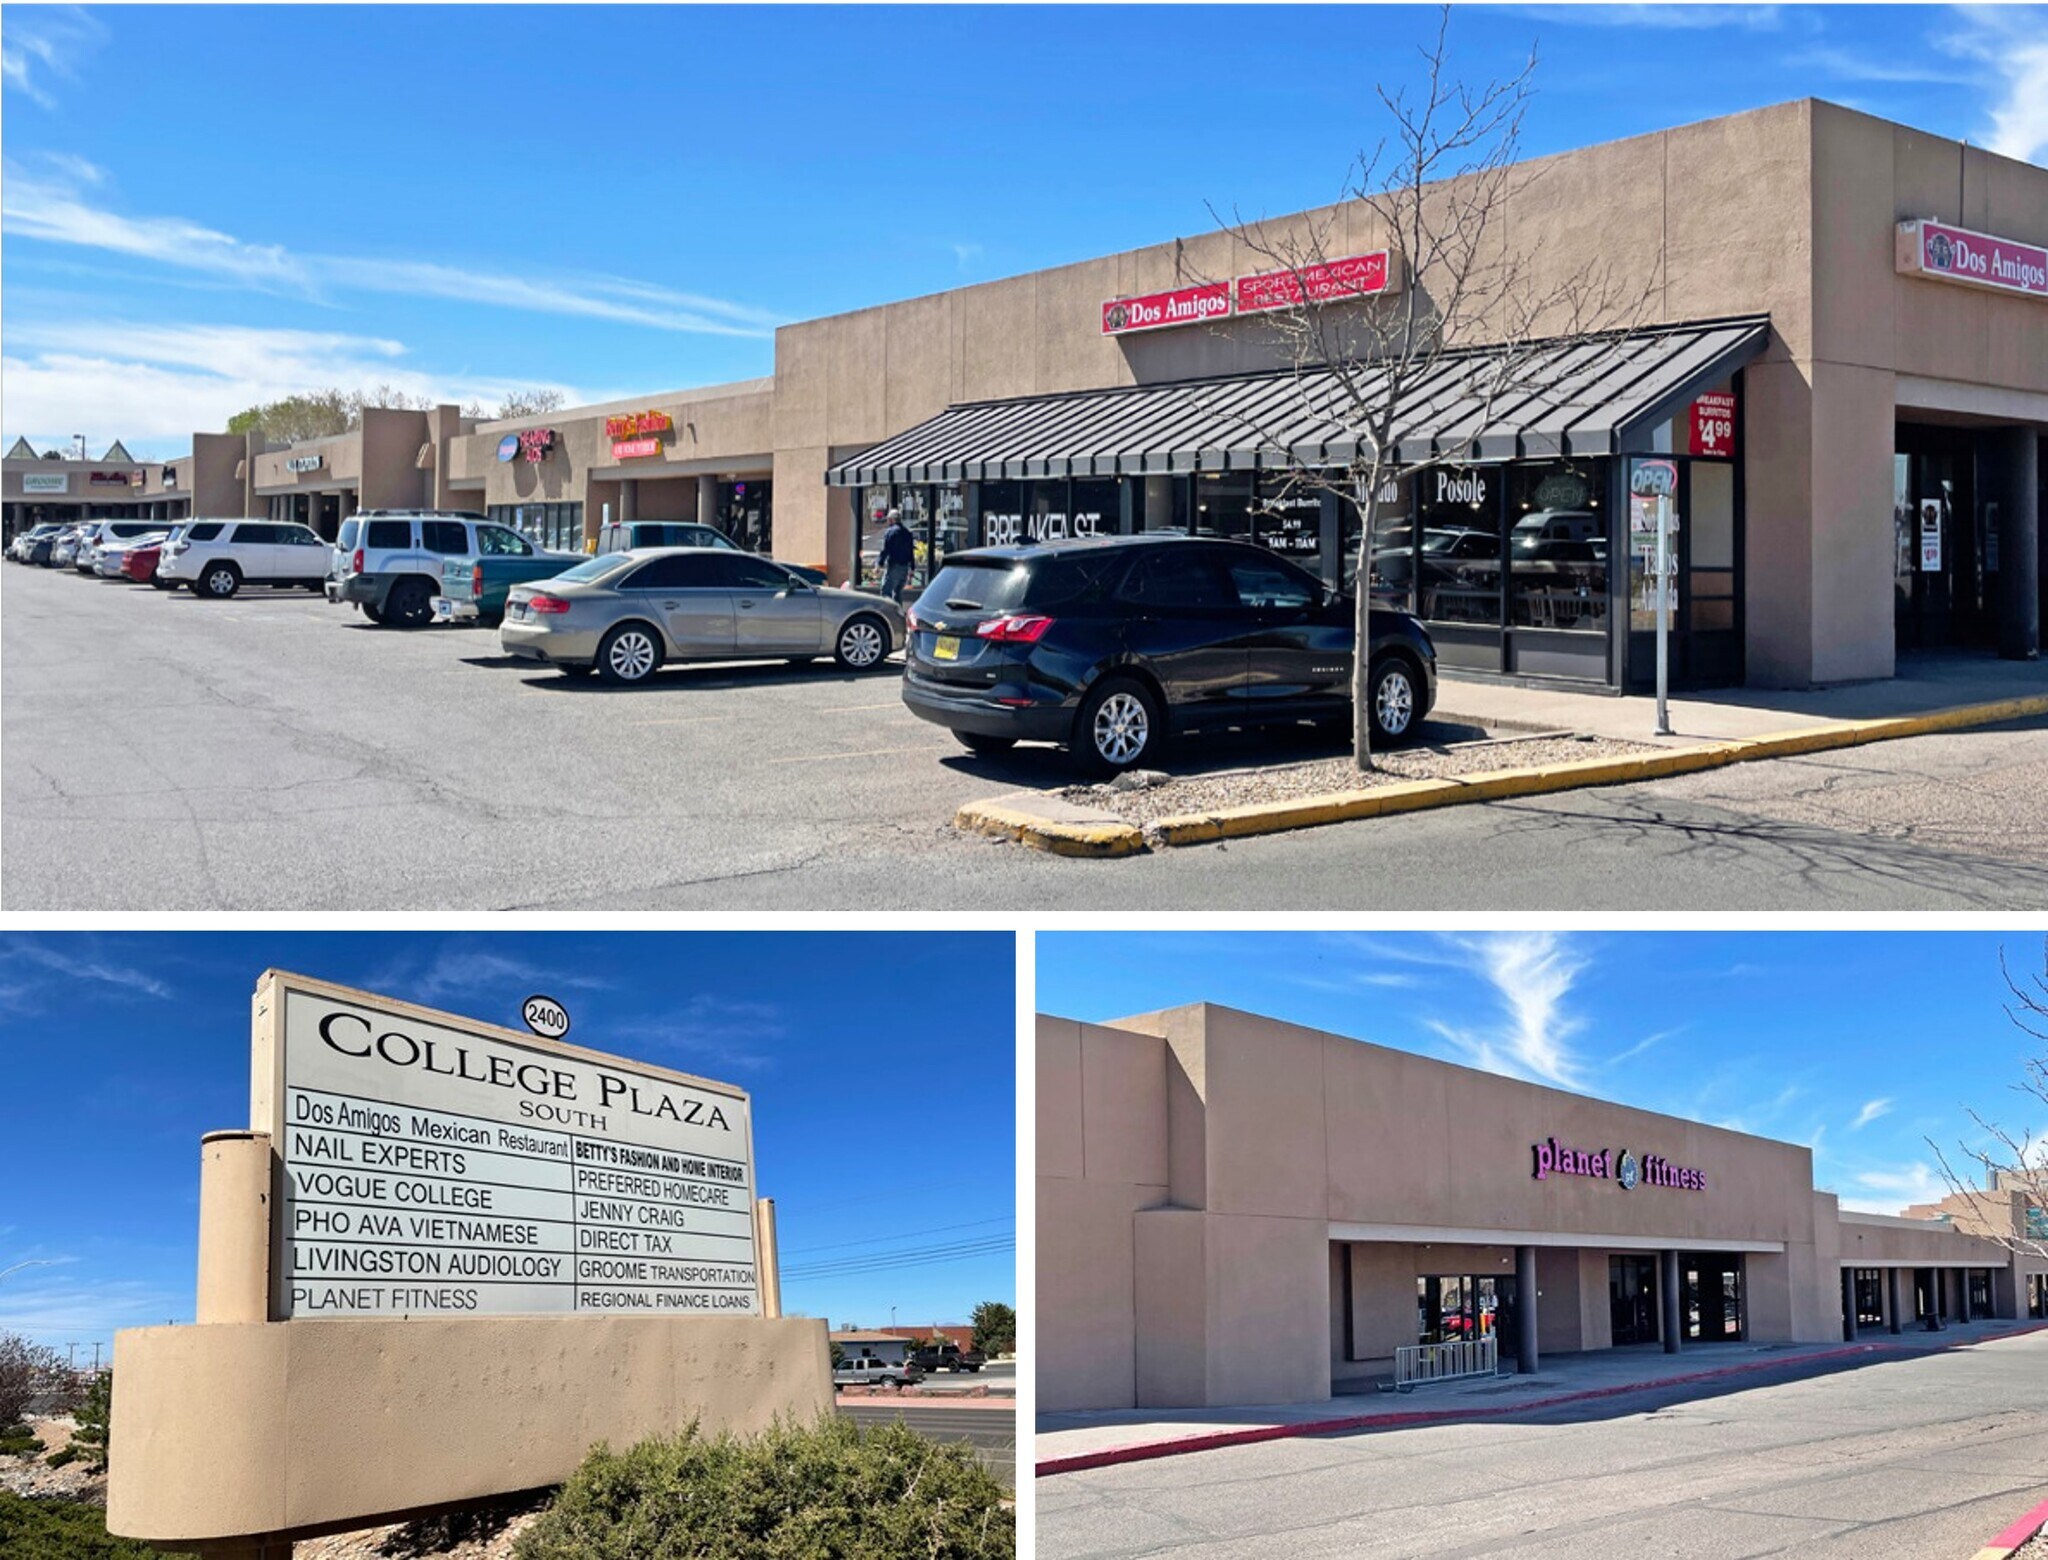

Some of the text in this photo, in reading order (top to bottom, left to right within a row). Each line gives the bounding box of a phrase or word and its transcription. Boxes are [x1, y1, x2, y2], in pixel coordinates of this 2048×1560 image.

[1956, 240, 2046, 289] Dos Amigos
[1131, 293, 1227, 324] Dos Amigos
[1436, 471, 1486, 503] Posole
[1631, 469, 1674, 494] OPEN
[528, 1003, 565, 1030] 2400
[318, 1012, 732, 1132] COLLEGE PLAZA
[295, 1094, 569, 1158] Dos Amigos Mexican Restaurant
[518, 1100, 608, 1132] SOUTH
[295, 1133, 467, 1175] NAIL EXPERTS
[575, 1140, 744, 1183] BETTY'S FASHION AND HOME INTERIOR
[1534, 1137, 1613, 1181] planet
[1644, 1154, 1708, 1191] fitness
[297, 1171, 493, 1209] VOGUE COLLEGE
[578, 1169, 730, 1206] PREFERRED HOMECARE
[295, 1209, 539, 1244] PHO AVA VIETNAMESE
[580, 1200, 685, 1227] JENNY CRAIG
[580, 1229, 674, 1254] DIRECT TAX
[293, 1247, 562, 1278] LIVINGSTON AUDIOLOGY
[579, 1260, 756, 1284] GROOME TRANSPORTATION
[290, 1288, 478, 1310] PLANET FITNESS
[580, 1291, 751, 1309] REGIONAL FINANCE LOANS
